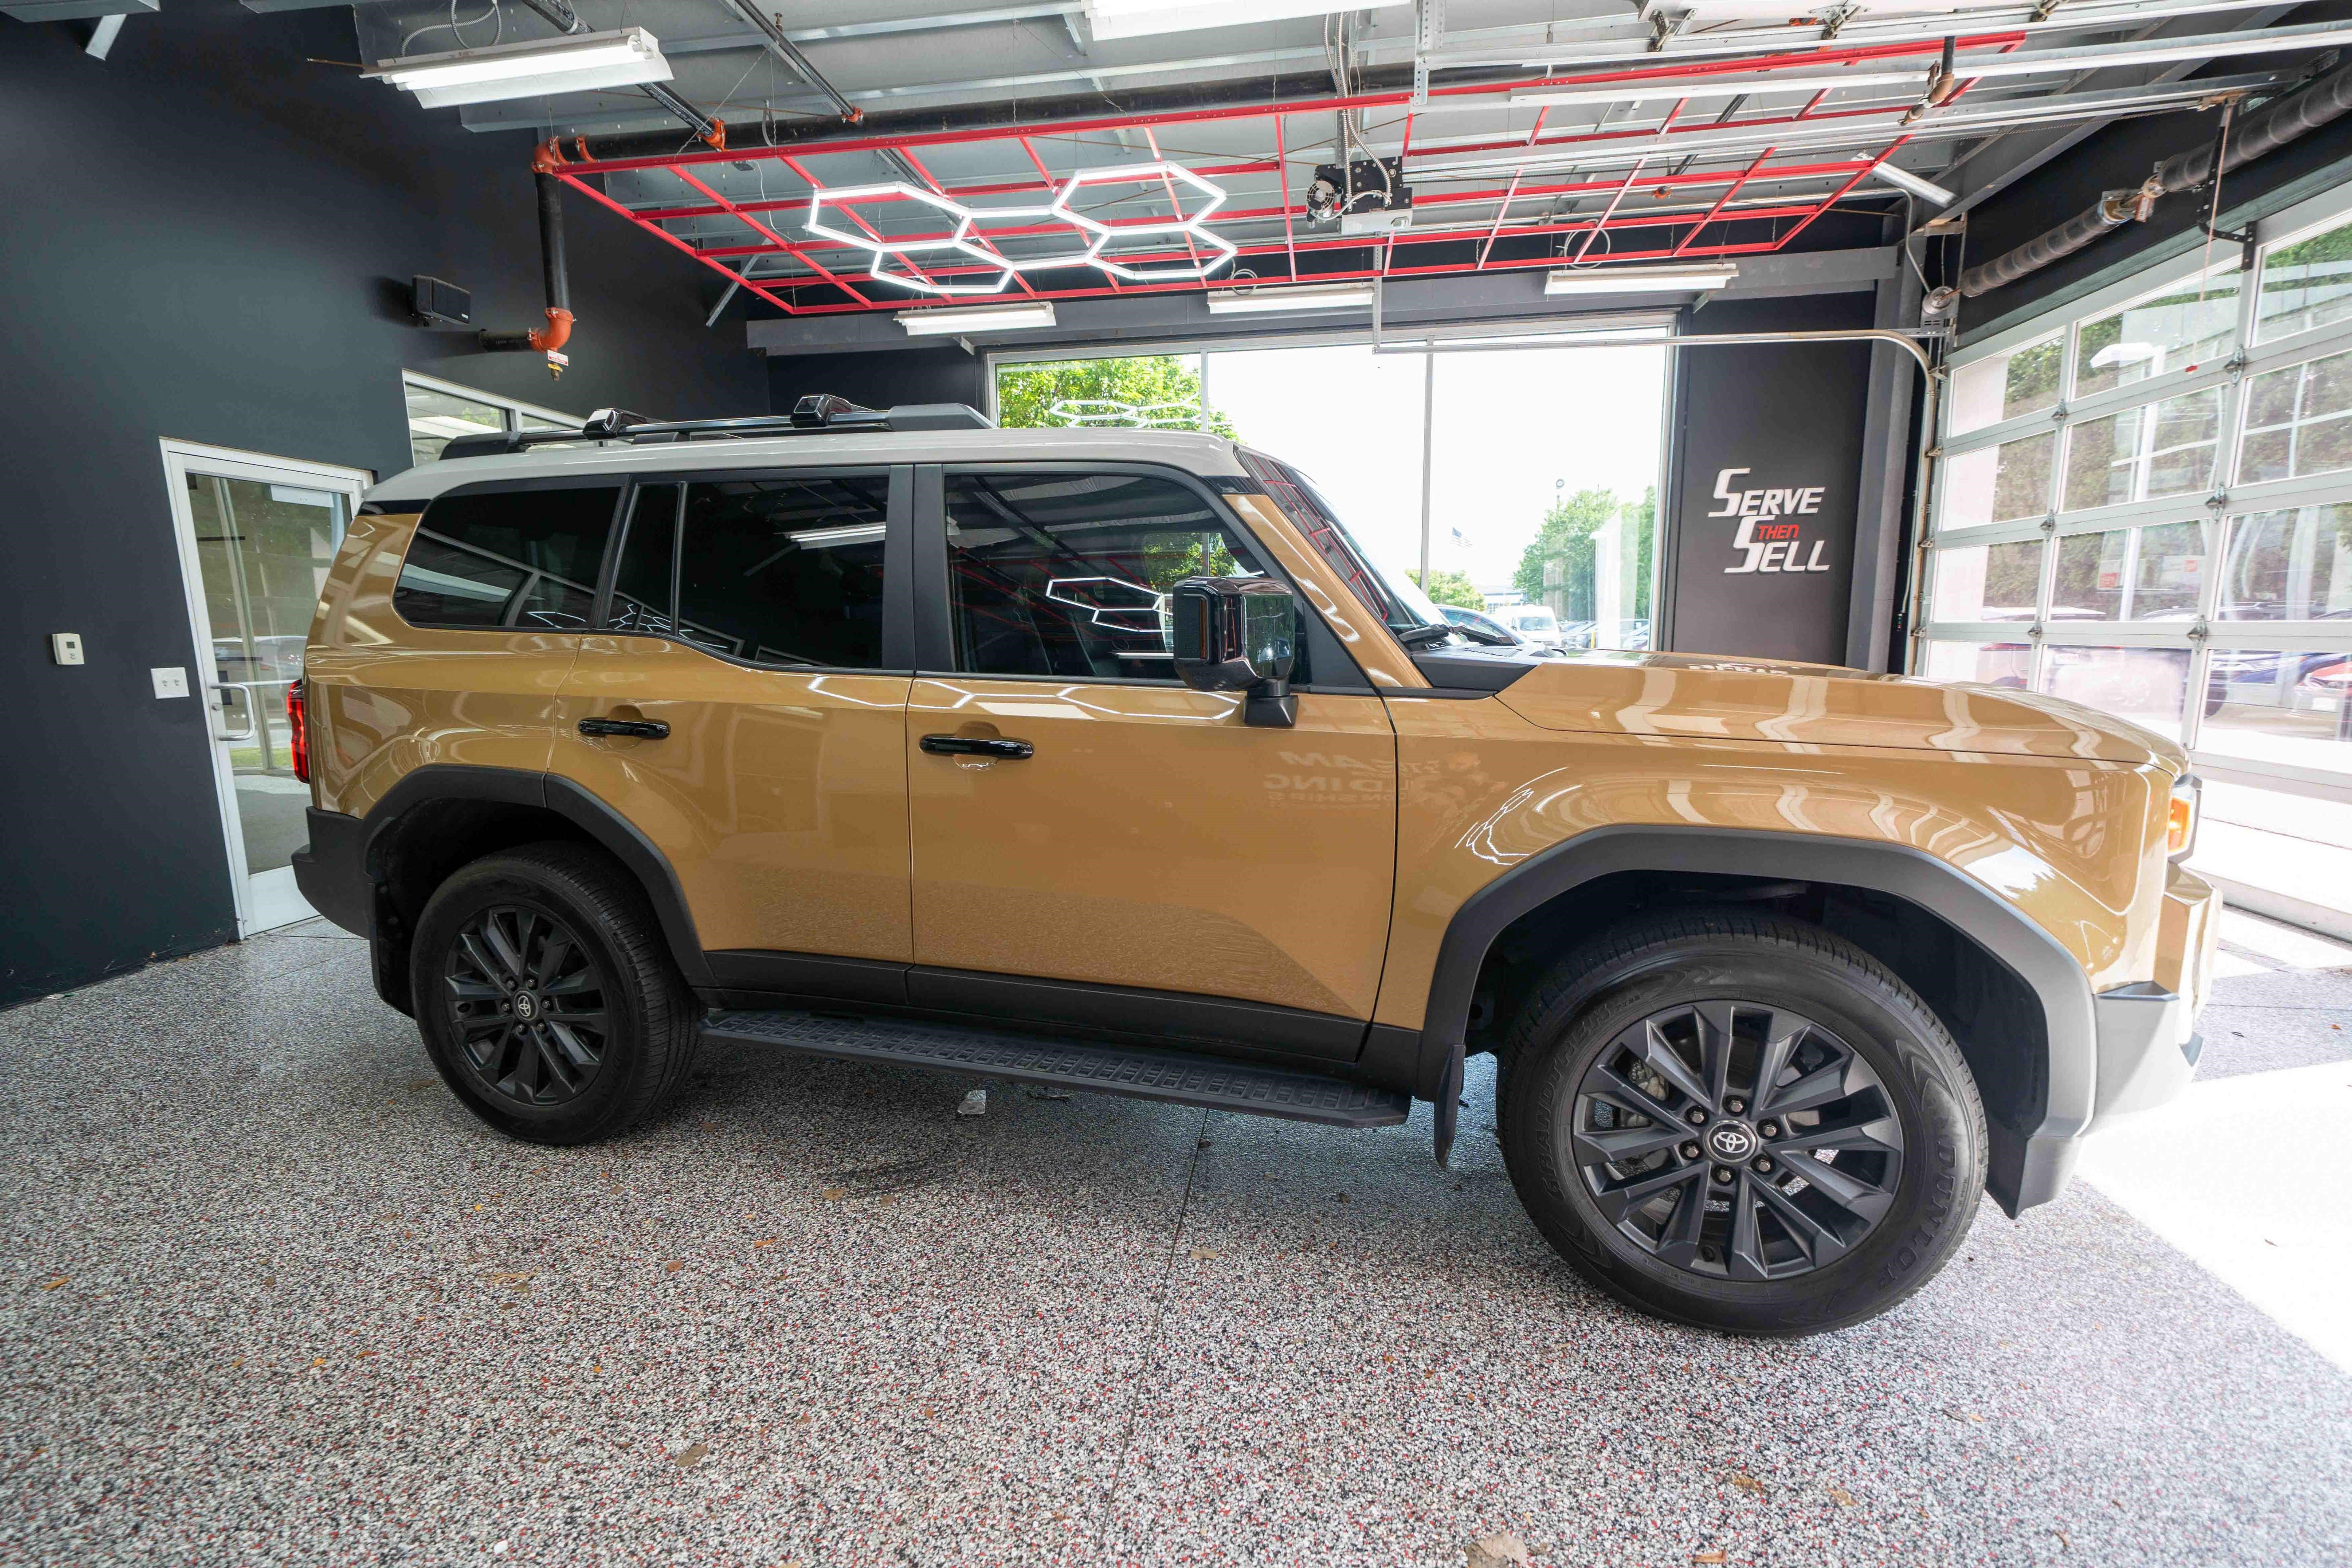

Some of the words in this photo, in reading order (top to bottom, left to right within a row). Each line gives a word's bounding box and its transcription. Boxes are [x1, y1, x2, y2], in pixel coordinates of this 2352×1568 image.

[1708, 468, 1825, 517] SERVE
[1724, 515, 1830, 573] SELL
[1757, 524, 1799, 540] THEN
[1880, 1141, 1957, 1285] DUNLOP
